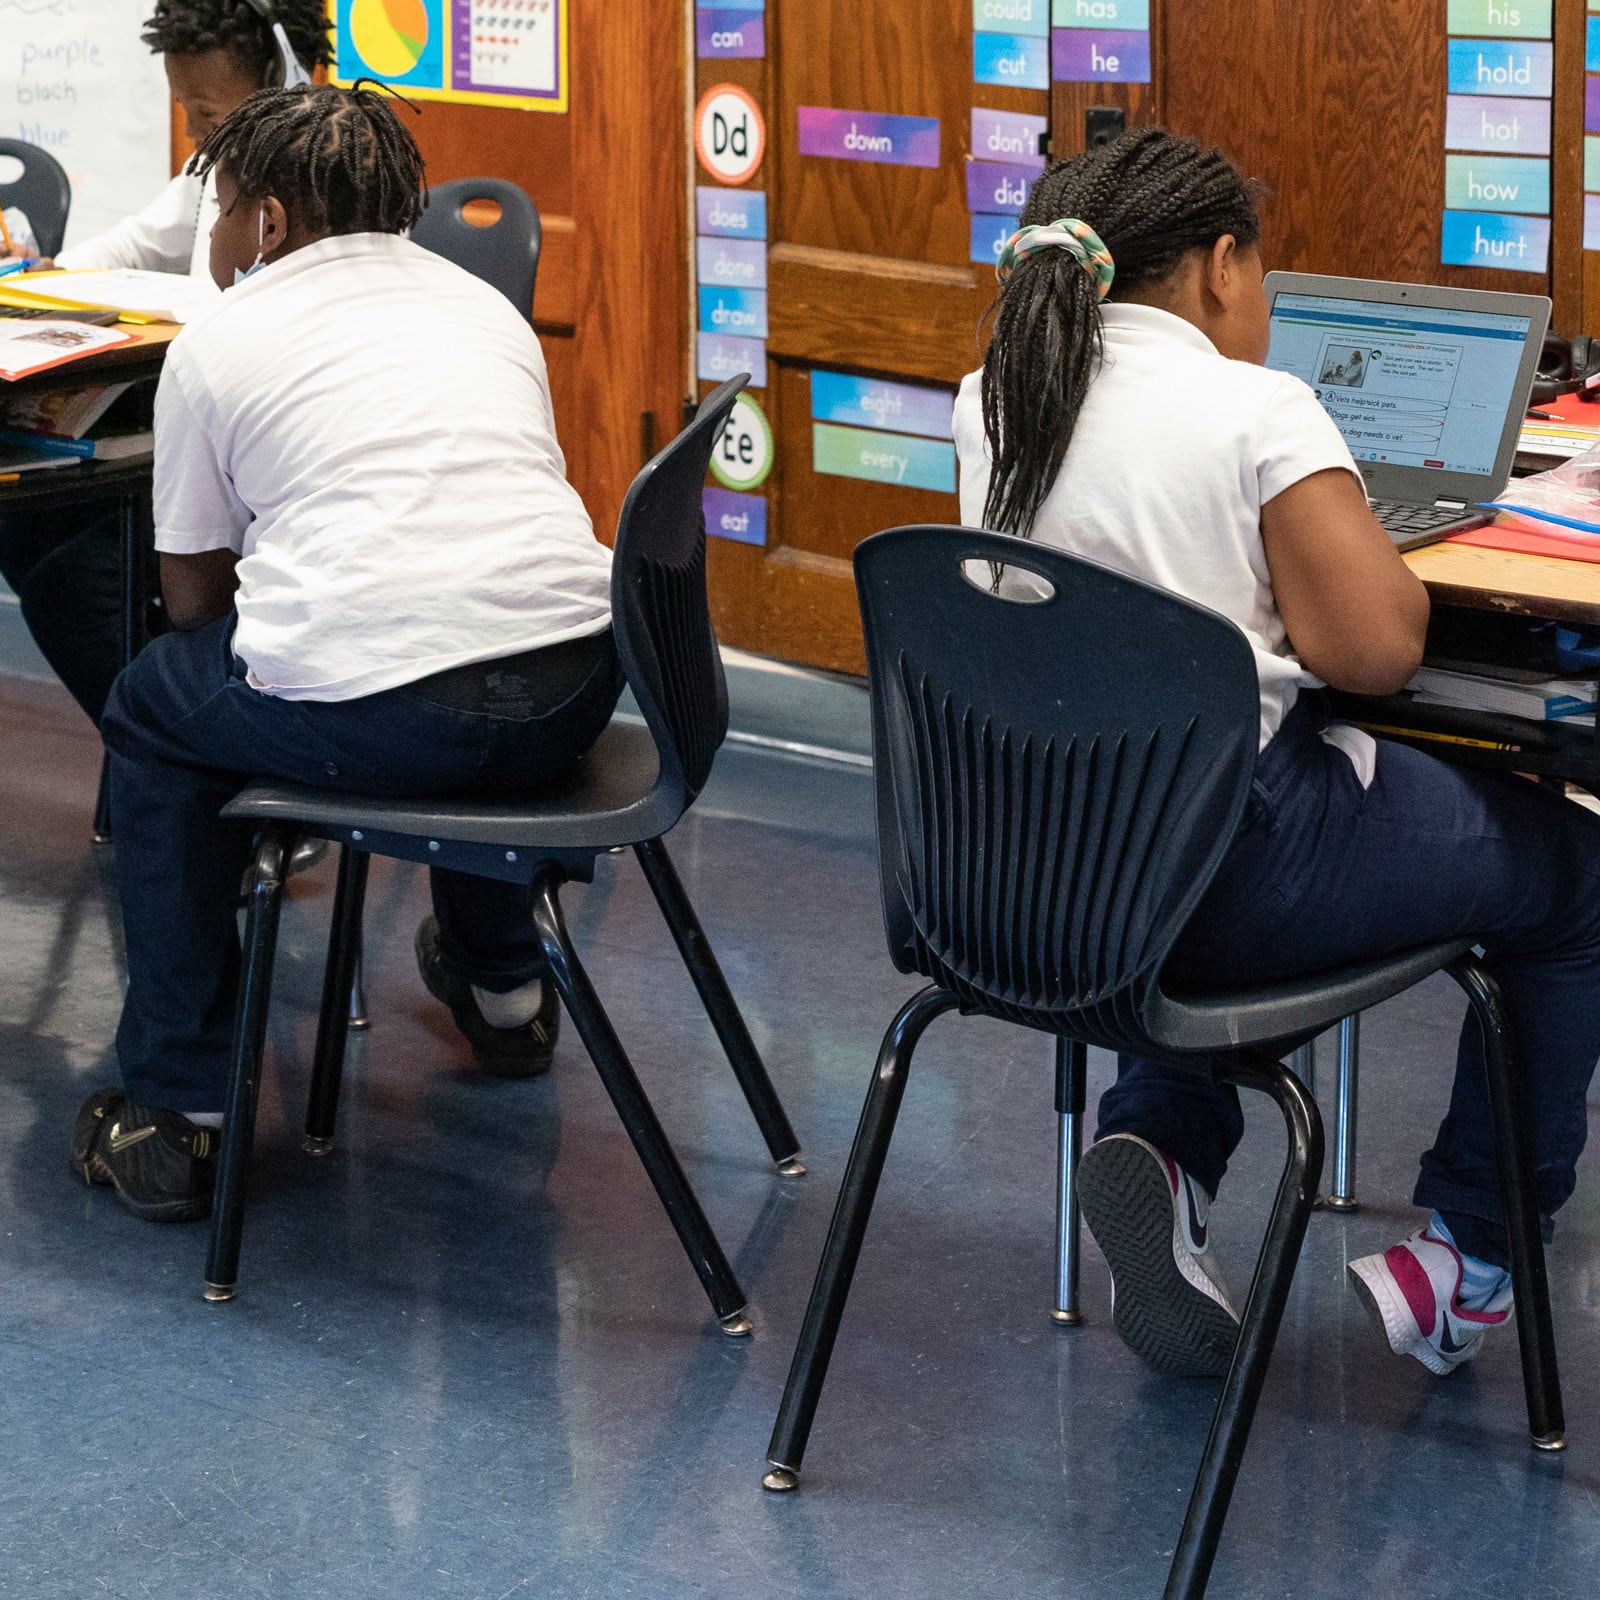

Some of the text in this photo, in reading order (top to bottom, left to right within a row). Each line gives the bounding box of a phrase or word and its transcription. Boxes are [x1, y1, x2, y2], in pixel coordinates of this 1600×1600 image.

[22, 39, 104, 75] purple
[712, 112, 747, 157] Dd
[844, 125, 891, 152] down
[994, 179, 1026, 205] did
[1476, 226, 1527, 257] hurt
[1332, 411, 1348, 419] Dogs
[1349, 429, 1362, 437] dog
[1364, 431, 1383, 439] needs
